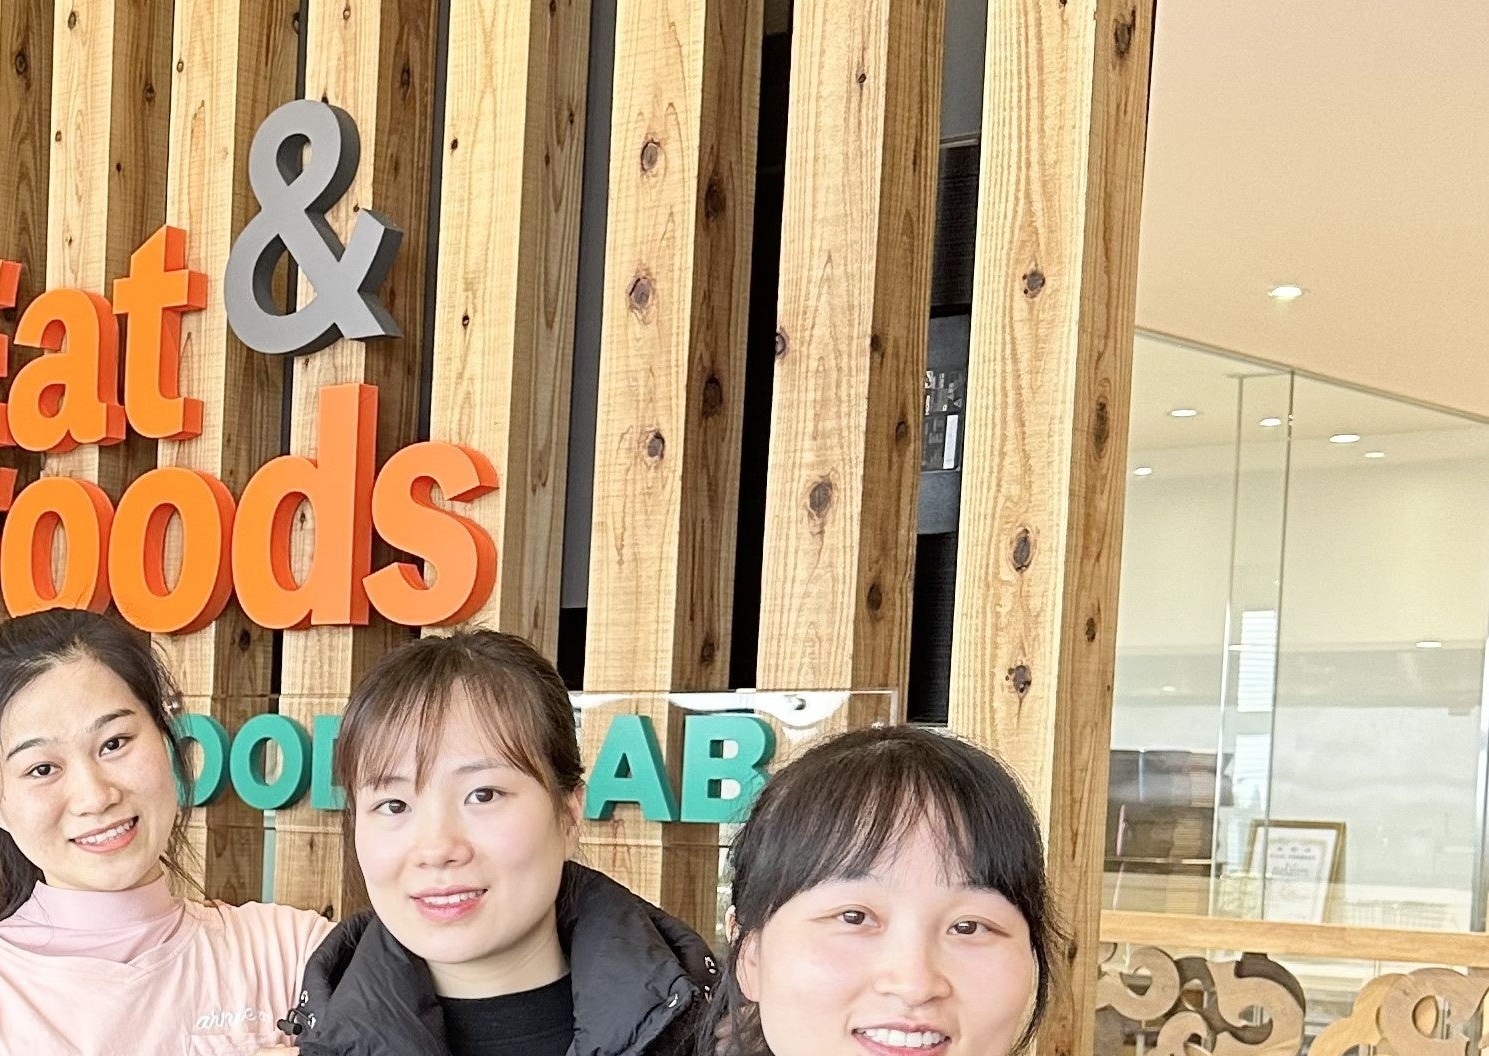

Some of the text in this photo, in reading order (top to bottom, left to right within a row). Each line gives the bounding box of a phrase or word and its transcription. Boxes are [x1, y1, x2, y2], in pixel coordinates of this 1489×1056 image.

[224, 99, 404, 355] &
[166, 713, 776, 823] OO AB
